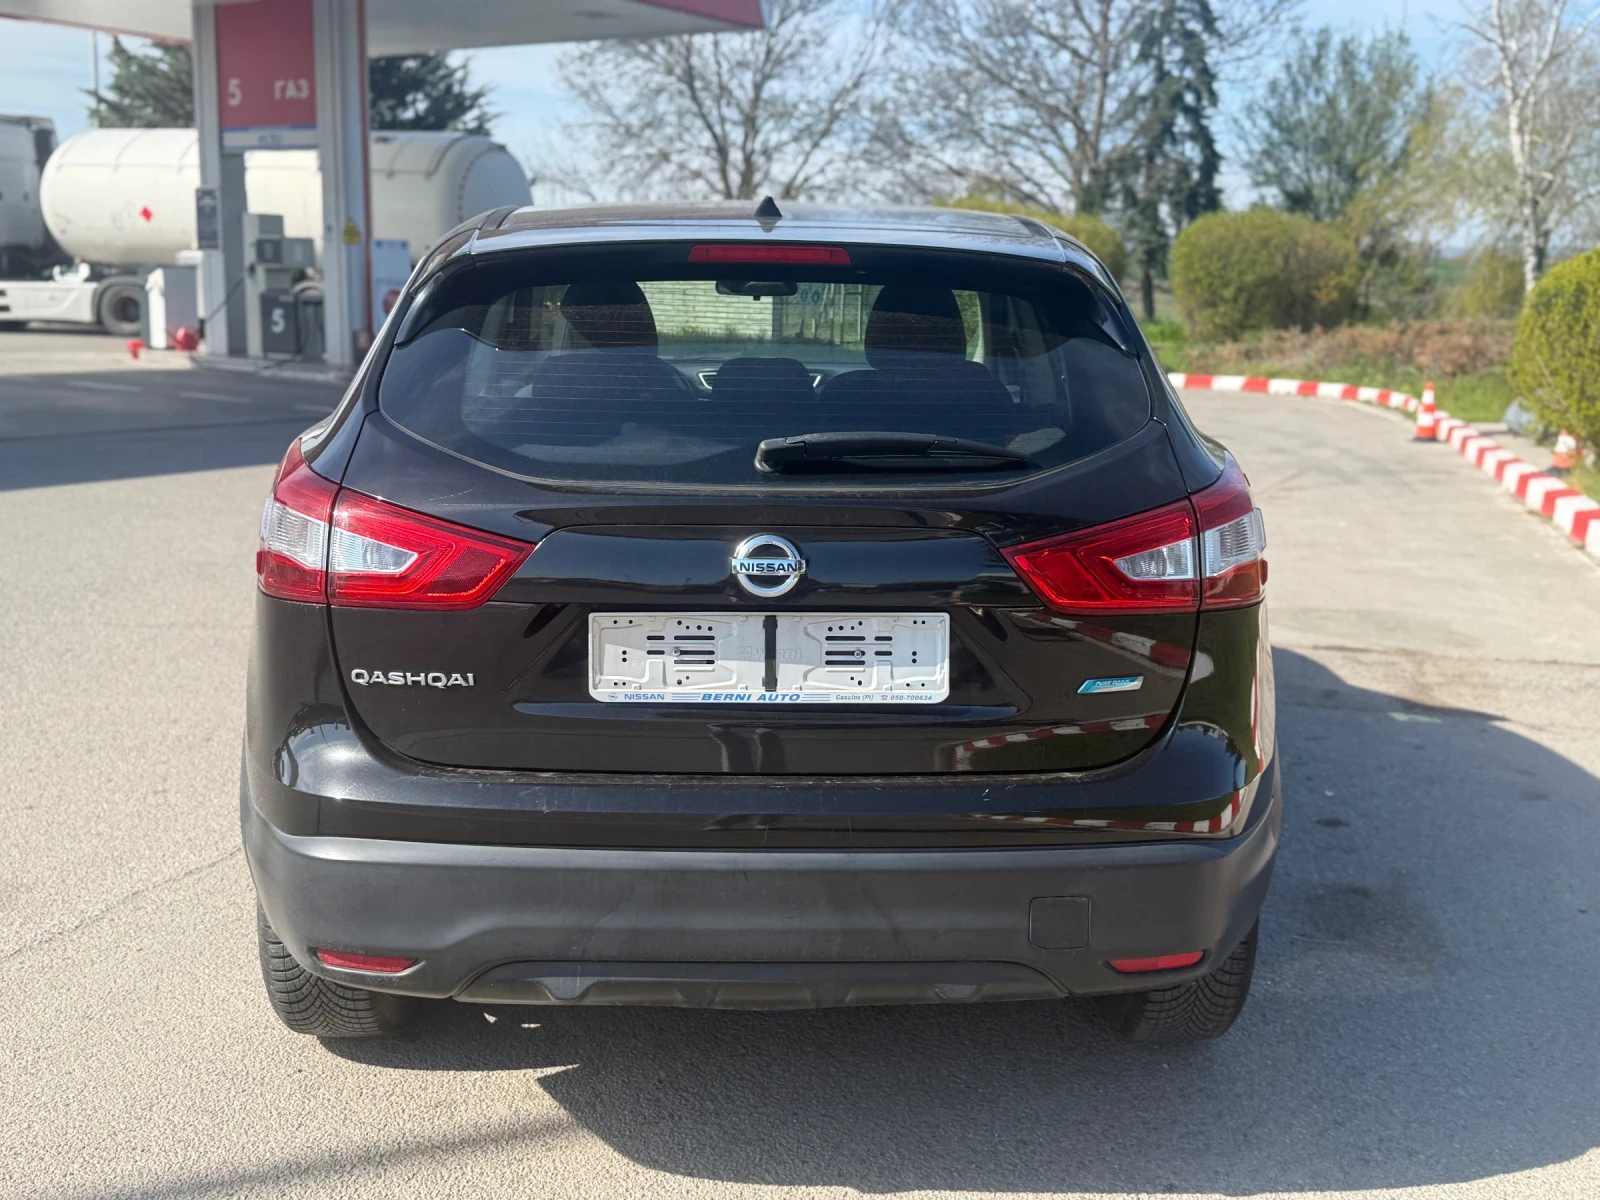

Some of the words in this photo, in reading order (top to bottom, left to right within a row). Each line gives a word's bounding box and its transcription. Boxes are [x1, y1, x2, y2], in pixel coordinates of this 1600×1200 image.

[226, 78, 243, 107] 5
[274, 79, 310, 100] ГАЗ
[270, 307, 286, 334] 5
[739, 562, 798, 572] NISSAN
[350, 668, 475, 690] QASHQAI
[701, 693, 752, 701] BERNI
[756, 693, 801, 701] AUTO
